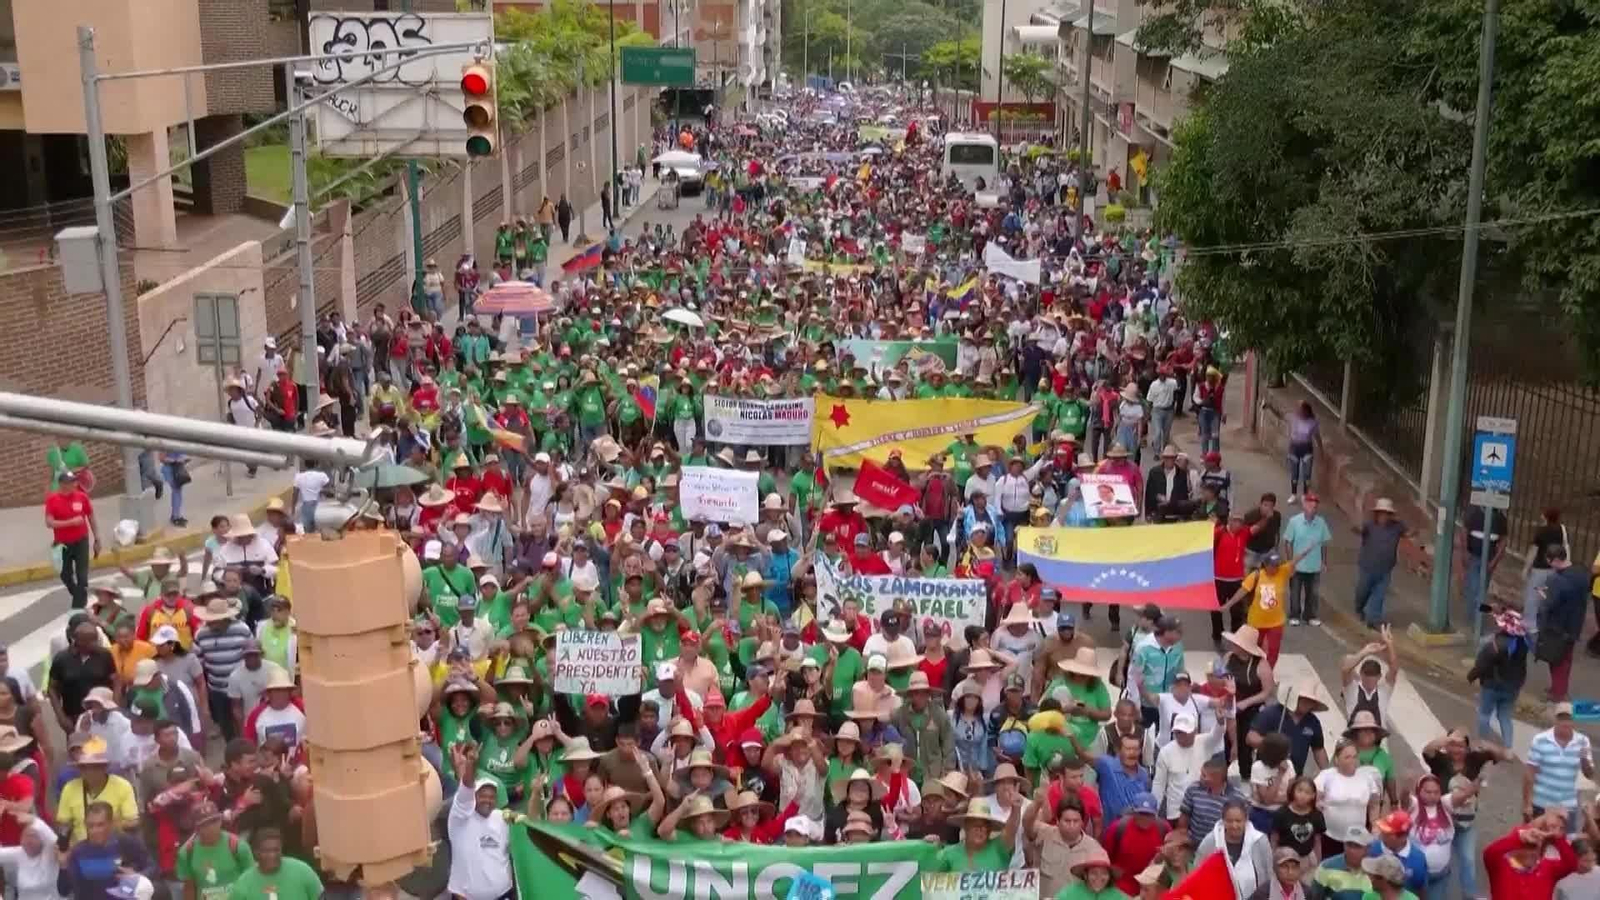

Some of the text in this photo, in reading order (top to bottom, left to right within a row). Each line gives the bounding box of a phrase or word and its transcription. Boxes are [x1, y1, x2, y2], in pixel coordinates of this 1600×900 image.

[740, 410, 773, 420] NICOLAS
[774, 410, 809, 420] MADURO
[904, 598, 977, 619] AFAEL"
[561, 631, 609, 645] LIBEREN
[560, 648, 637, 662] A NUESTRO
[556, 664, 640, 680] PRESIDENTE
[580, 680, 597, 694] YA
[920, 870, 1036, 892] VENEZUELA
